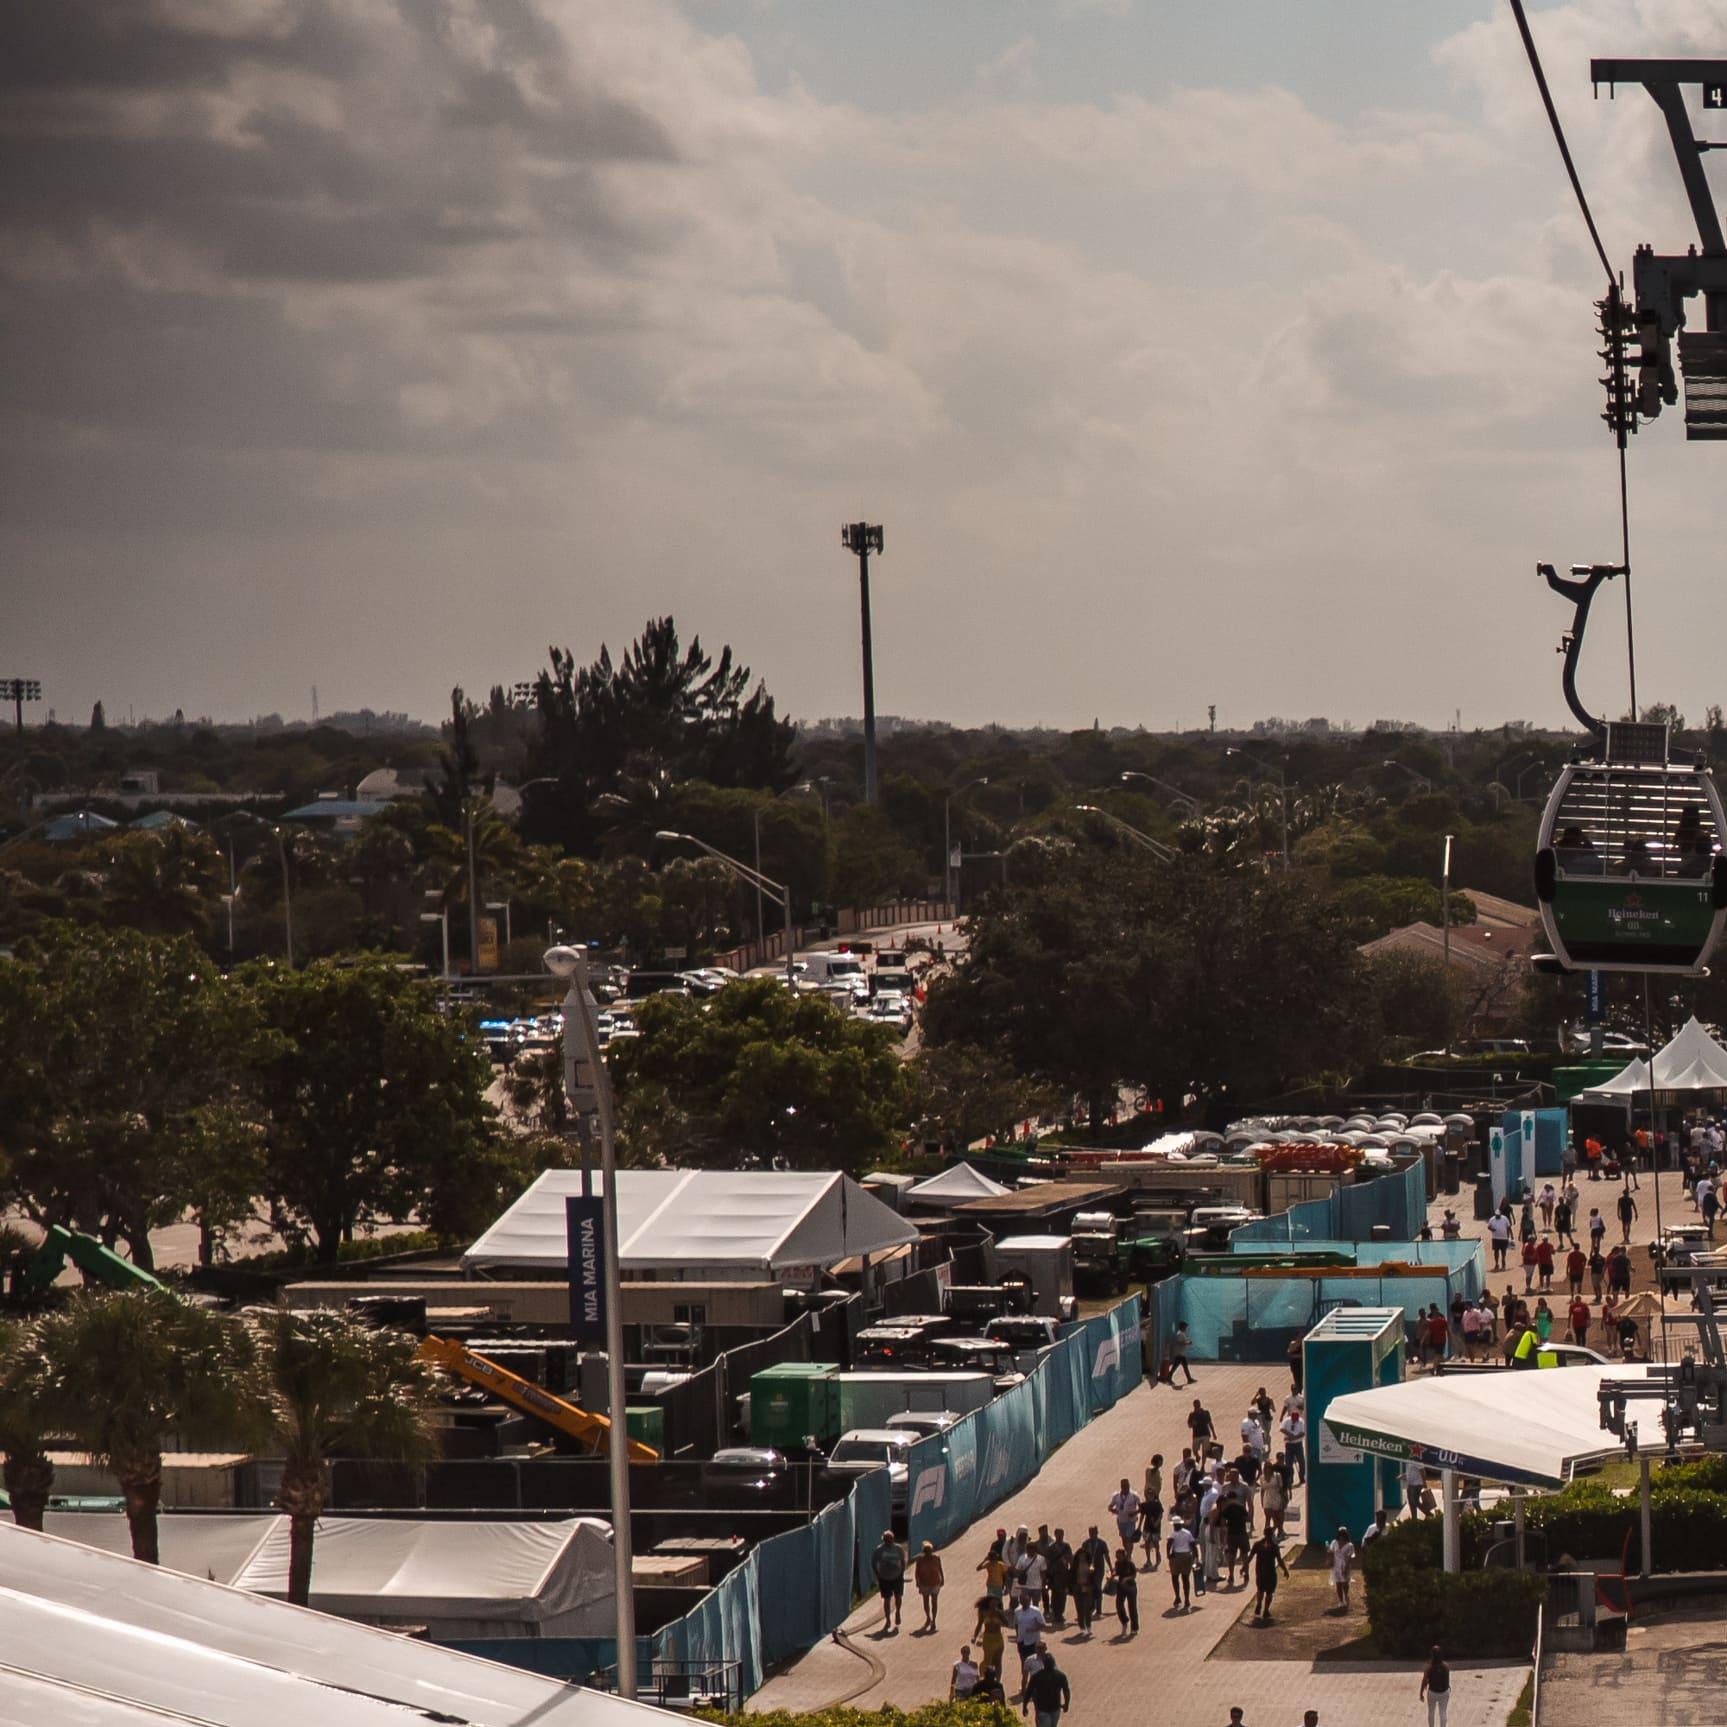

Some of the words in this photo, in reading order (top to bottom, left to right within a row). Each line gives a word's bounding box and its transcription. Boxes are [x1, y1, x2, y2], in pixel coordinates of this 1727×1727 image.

[1711, 88, 1722, 107] 4
[1697, 892, 1708, 903] 11
[1608, 908, 1659, 920] Heineken
[580, 1217, 597, 1285] MARINA
[583, 1289, 599, 1322] MIA
[464, 1356, 494, 1376] JCB
[1340, 1432, 1403, 1453] Heineken
